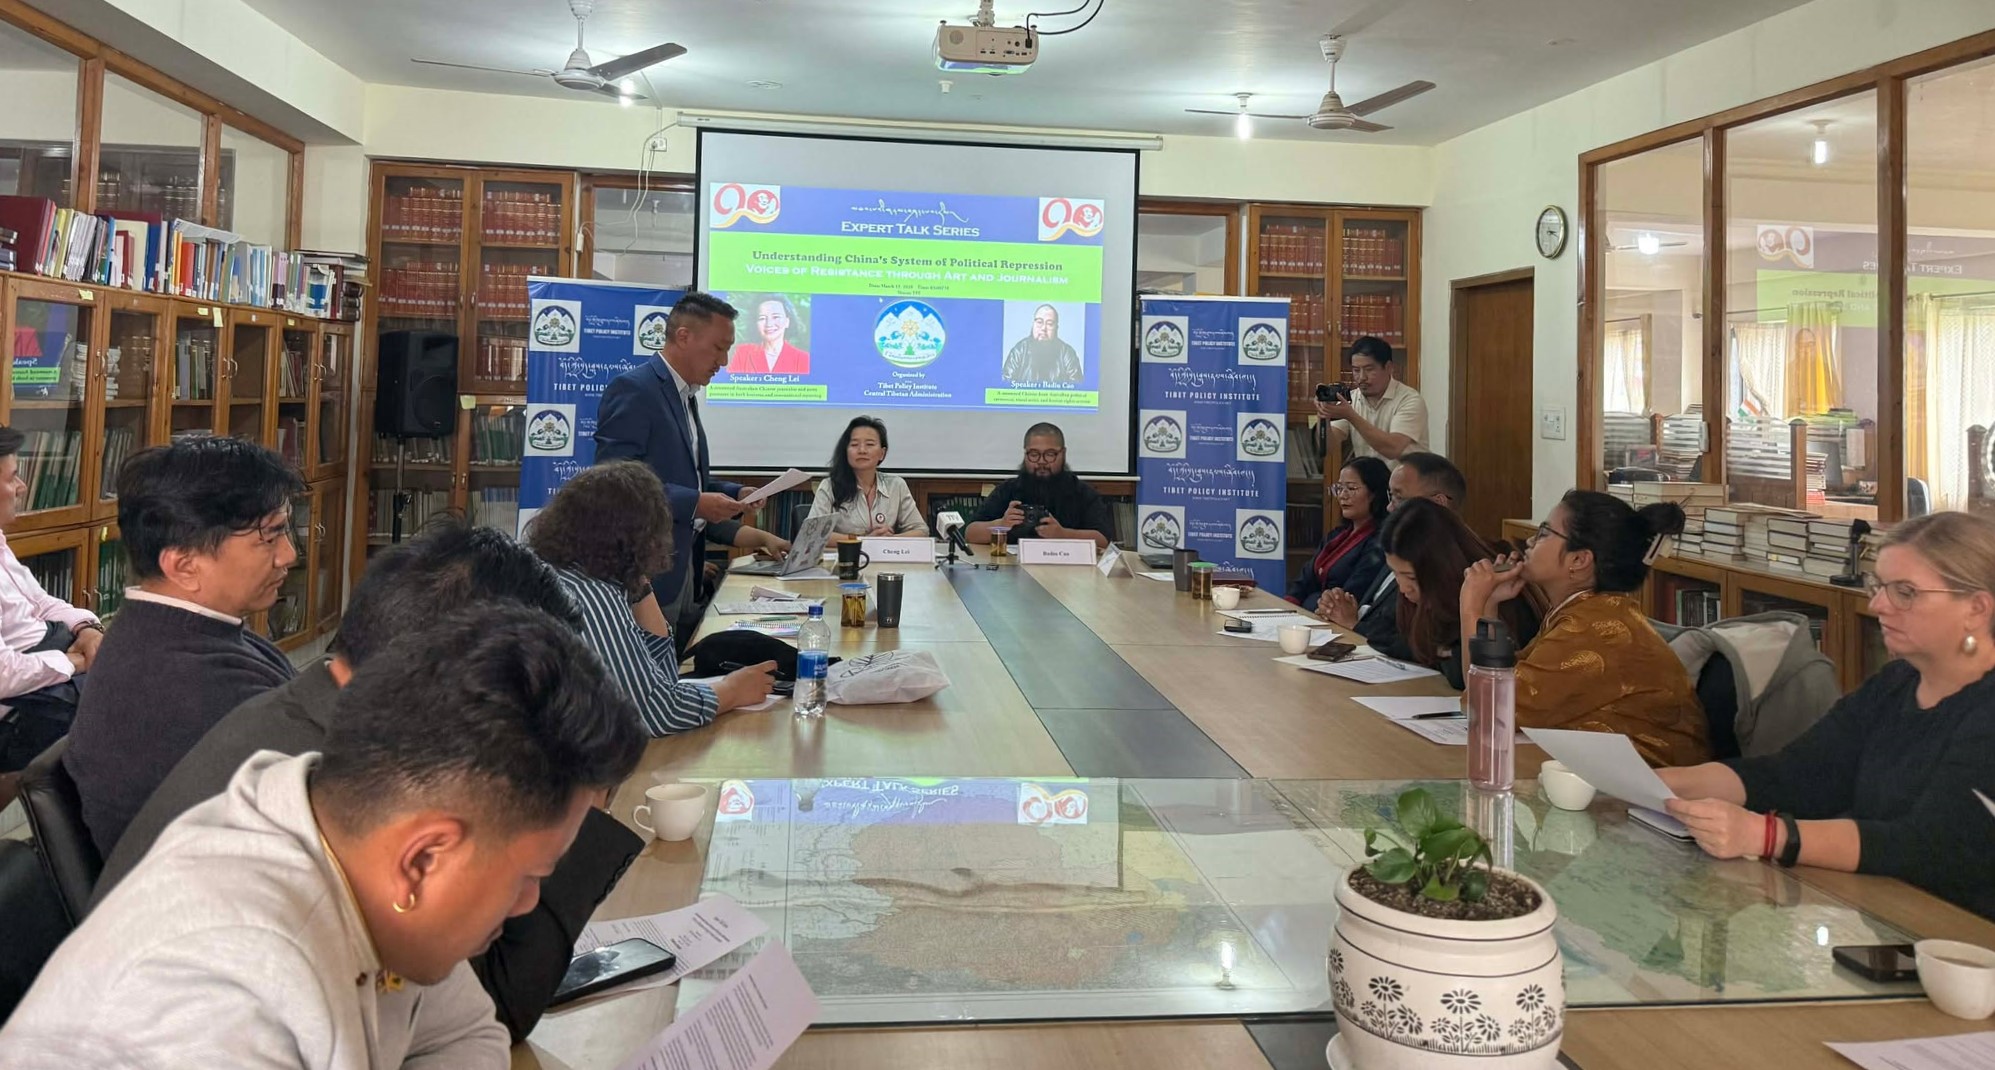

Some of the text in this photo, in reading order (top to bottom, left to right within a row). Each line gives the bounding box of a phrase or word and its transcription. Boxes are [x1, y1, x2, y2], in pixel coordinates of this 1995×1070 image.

[841, 221, 980, 236] EXPERT TALK SERIES
[752, 250, 1062, 271] Understanding China's System of Political Repression
[730, 374, 758, 382] Speaker
[764, 374, 787, 383] Cheng
[1011, 380, 1036, 389] Speaker
[1220, 392, 1260, 400] INSTITUTE
[1219, 488, 1259, 497] INSTITUTE
